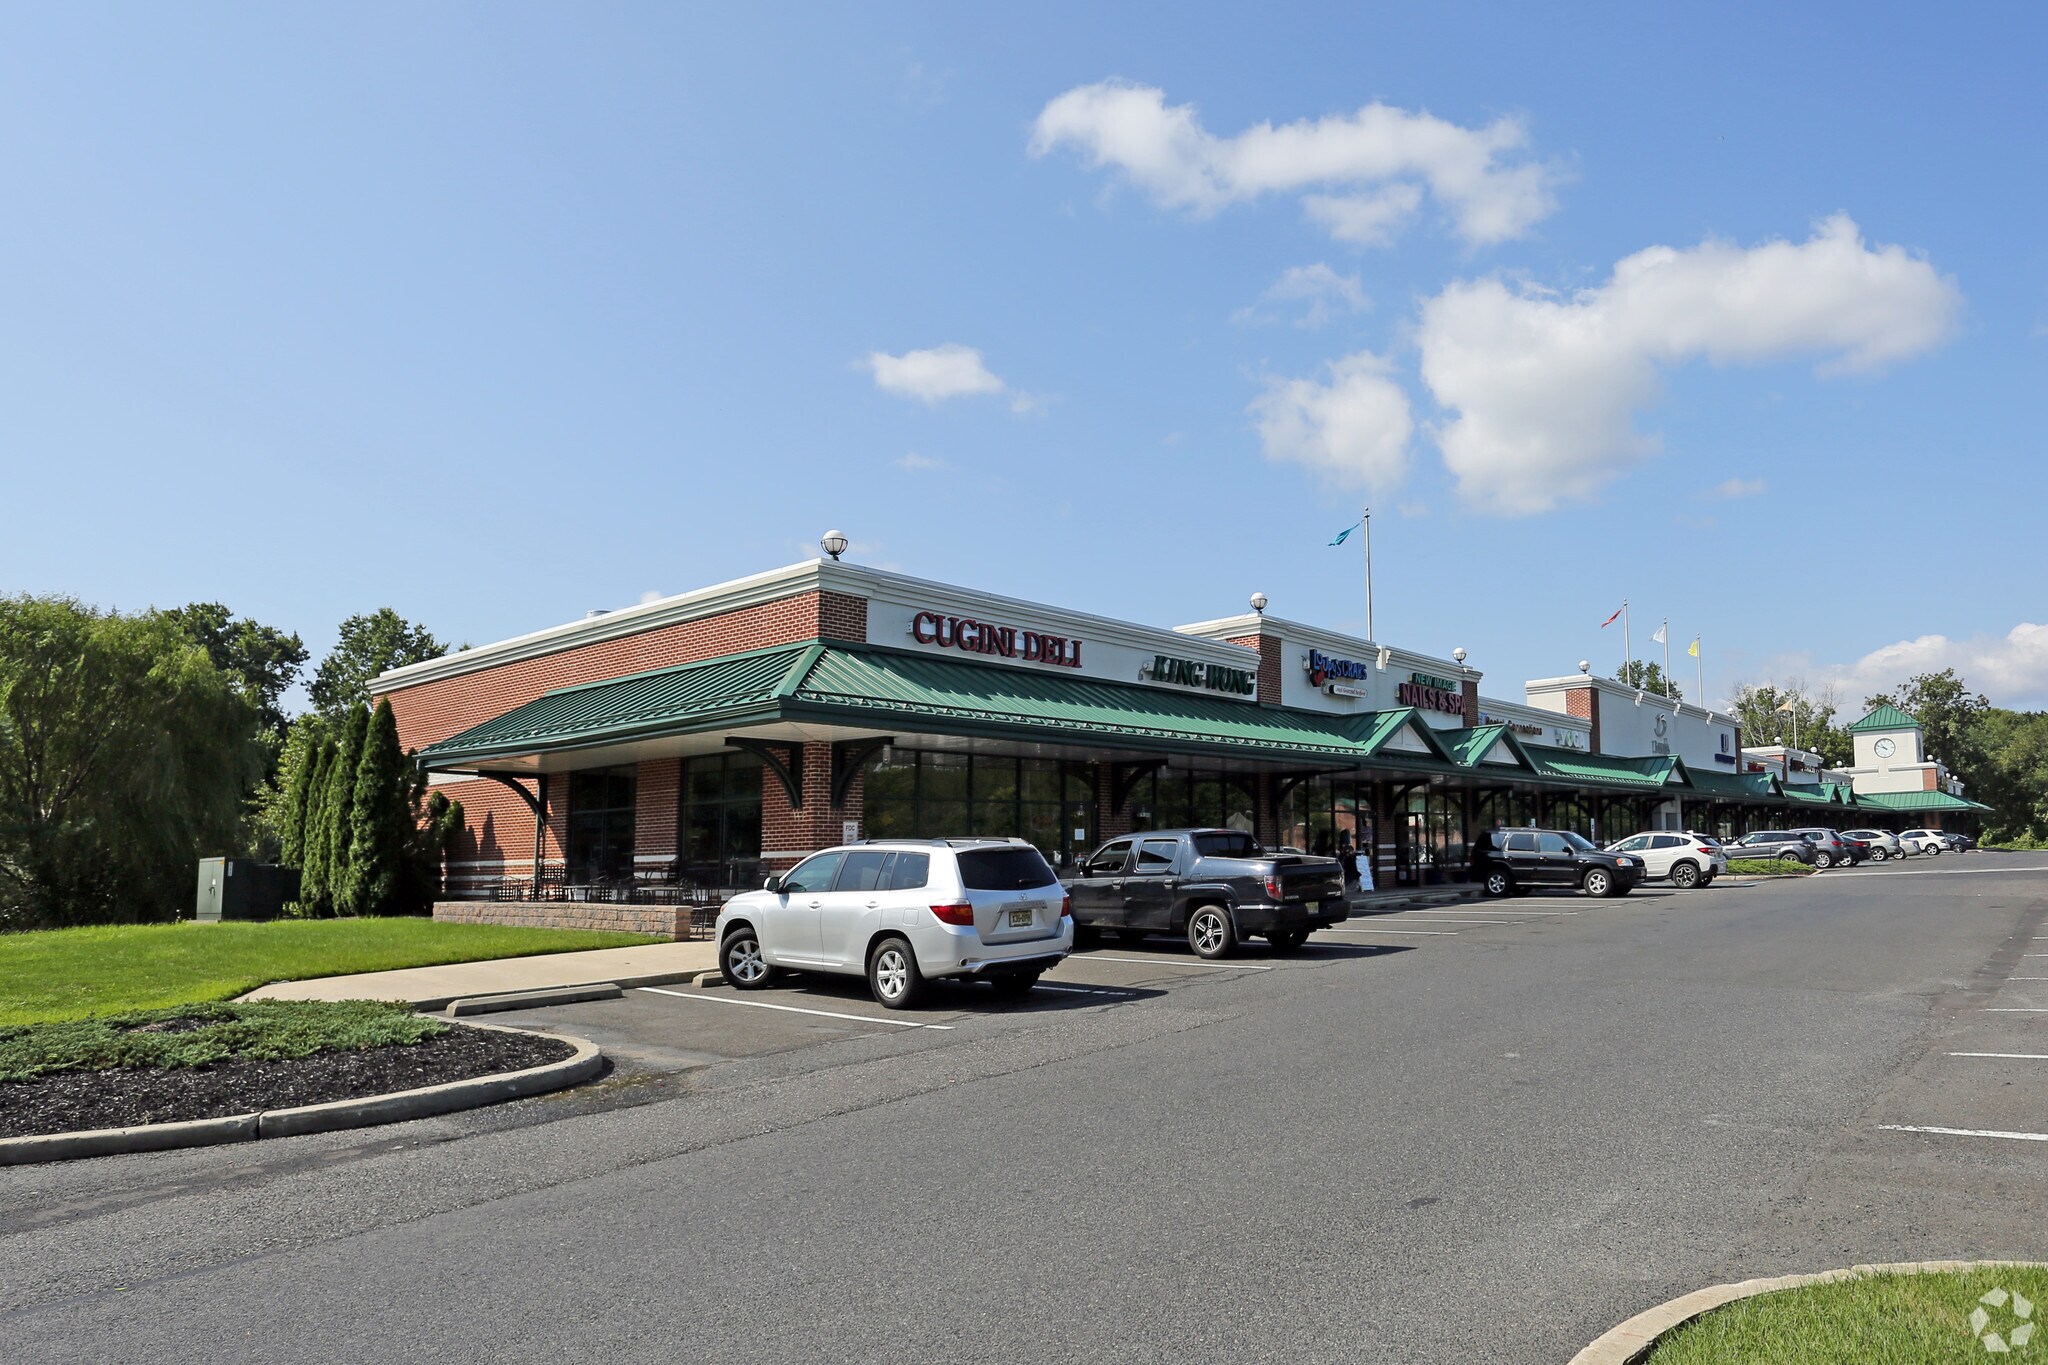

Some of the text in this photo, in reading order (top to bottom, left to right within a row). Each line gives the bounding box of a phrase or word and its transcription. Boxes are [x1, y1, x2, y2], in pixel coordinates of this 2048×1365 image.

[913, 611, 1082, 668] CUGINI DELI
[1151, 655, 1256, 695] KING WONG
[1413, 672, 1456, 692] NEW IMAGE
[1399, 683, 1467, 716] NAILS & SPA
